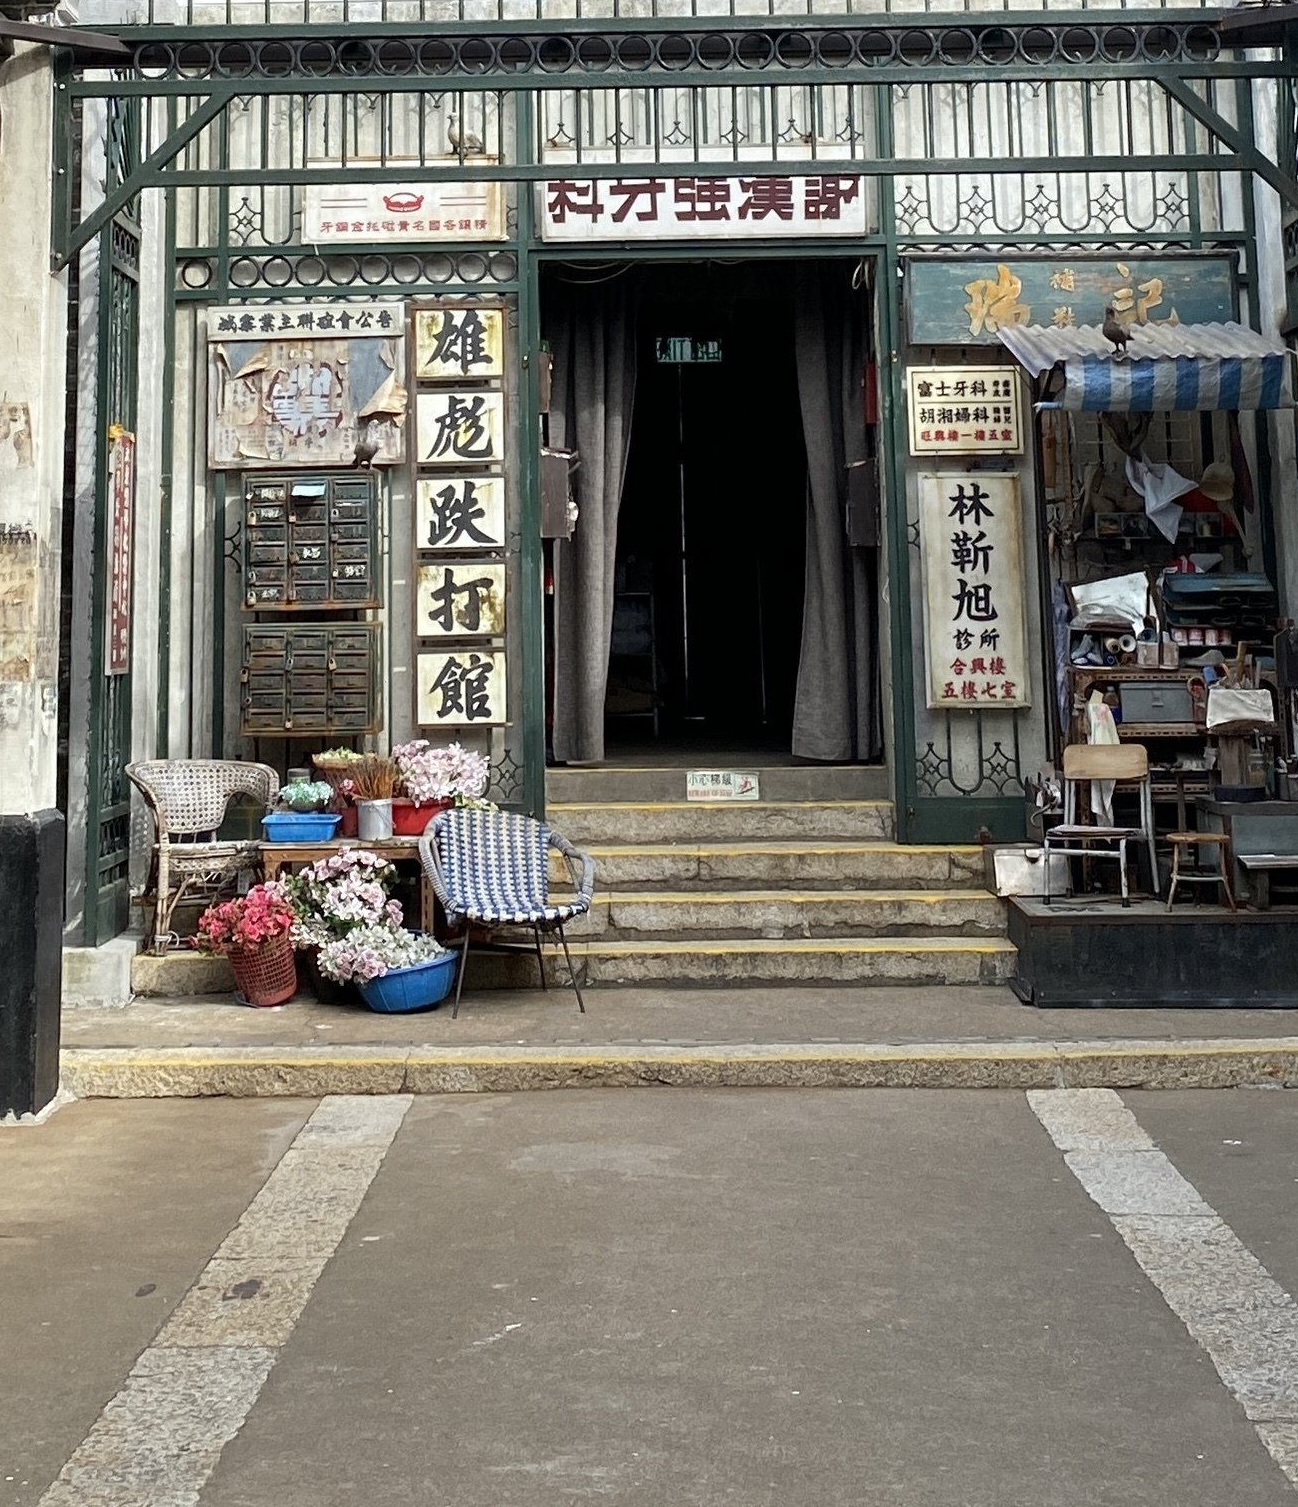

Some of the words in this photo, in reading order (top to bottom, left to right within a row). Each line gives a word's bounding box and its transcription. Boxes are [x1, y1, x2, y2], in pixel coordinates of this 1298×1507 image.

[917, 379, 988, 398] 富士牙科
[424, 308, 500, 723] 雄彪跌打館
[952, 628, 1000, 651] 診所
[941, 680, 1017, 700] 五樓七室
